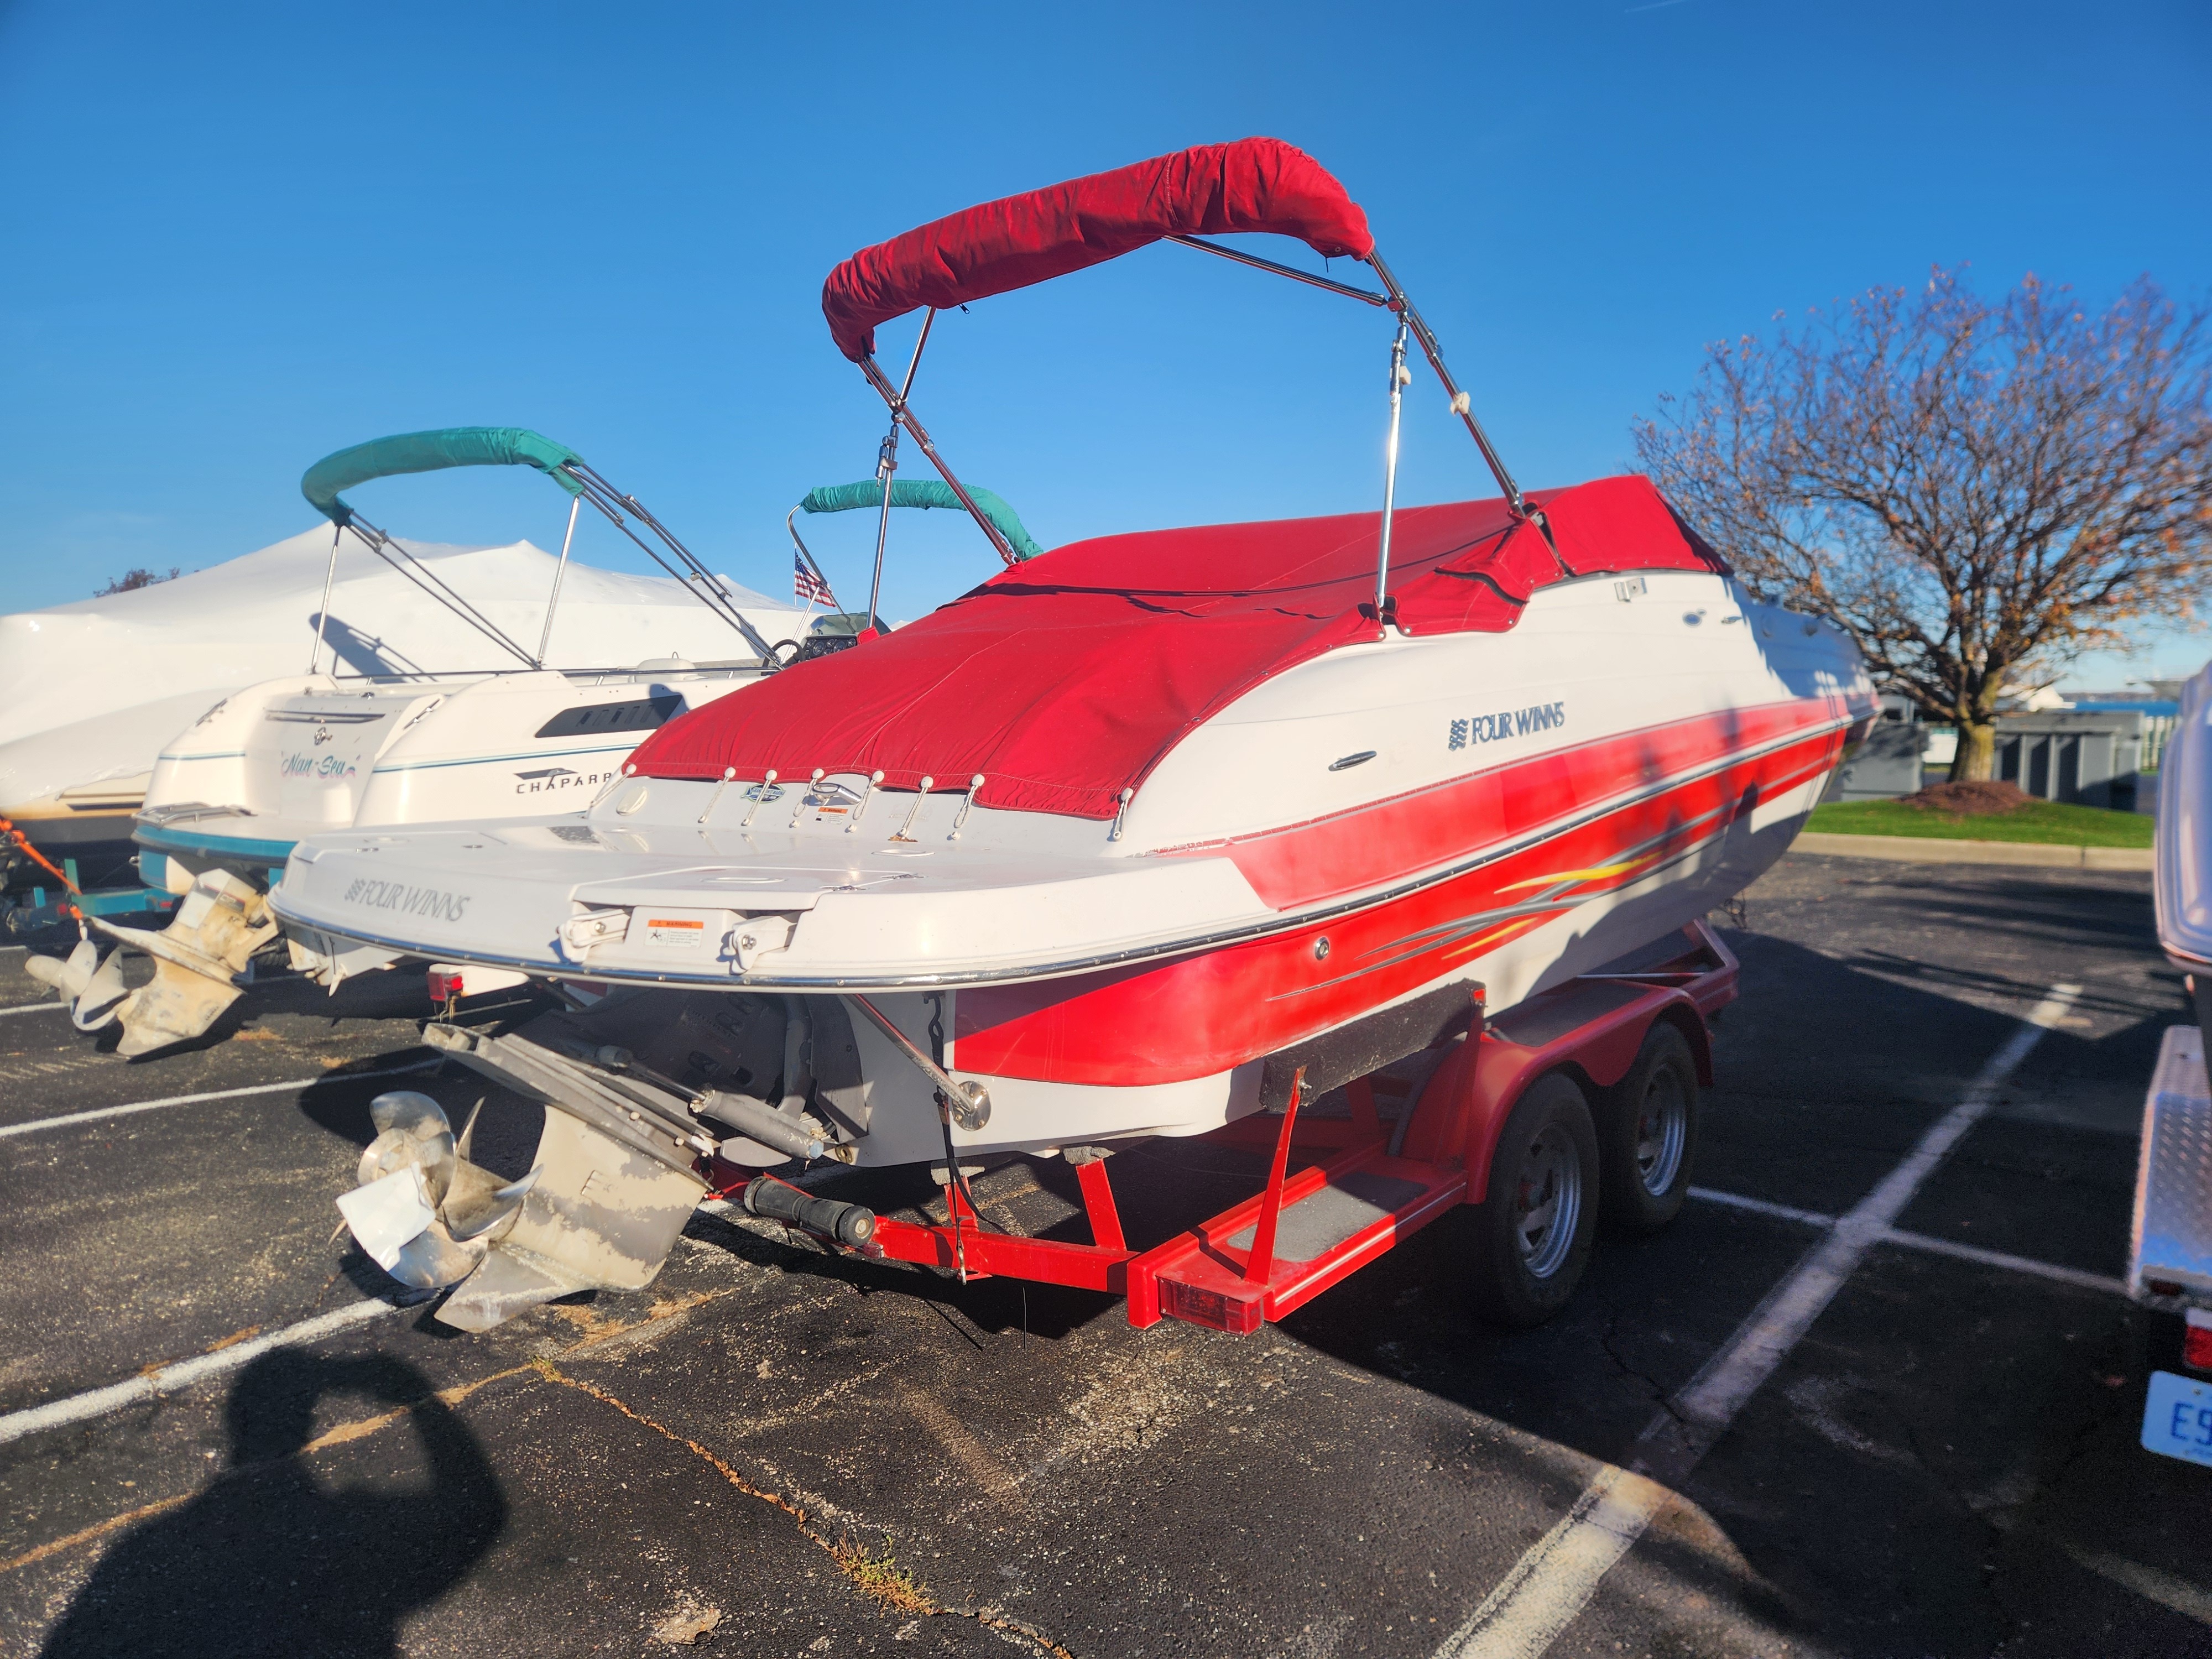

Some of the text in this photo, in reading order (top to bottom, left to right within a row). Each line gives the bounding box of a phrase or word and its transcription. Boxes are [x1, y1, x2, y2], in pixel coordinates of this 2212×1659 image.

[1471, 701, 1564, 745] FOUR WINNS
[359, 880, 471, 921] FOUR WINNS
